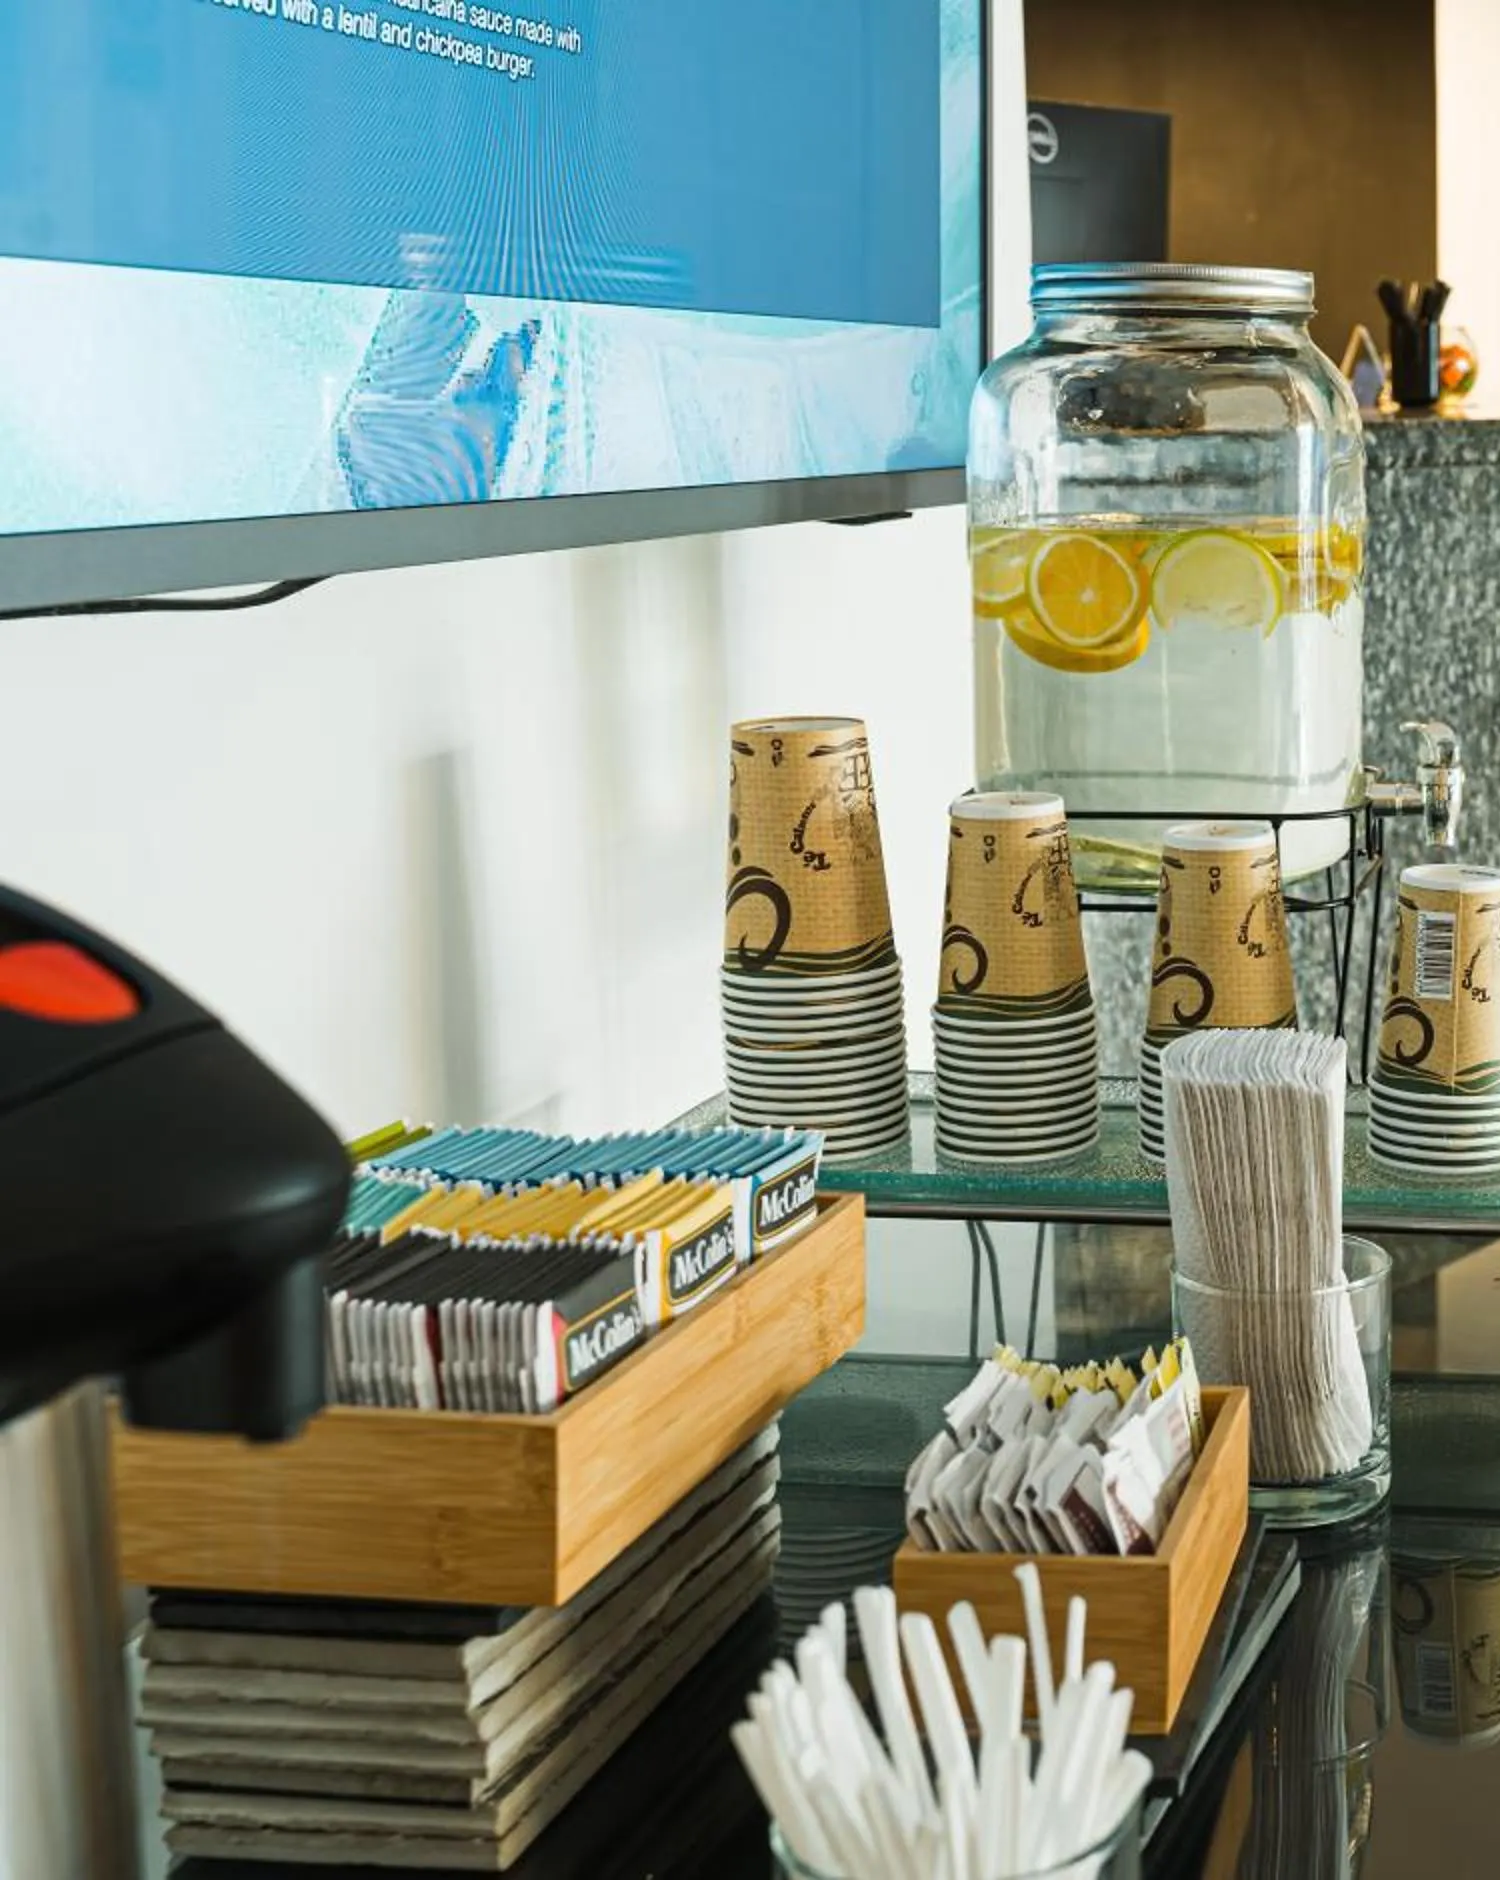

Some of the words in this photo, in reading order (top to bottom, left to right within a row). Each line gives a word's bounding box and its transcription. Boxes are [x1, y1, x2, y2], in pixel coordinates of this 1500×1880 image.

[281, 0, 318, 25] with
[321, 7, 334, 31] a
[338, 5, 377, 40] lentil
[381, 21, 412, 49] and
[416, 27, 483, 67] chickpea
[487, 43, 535, 80] burger.
[469, 5, 513, 35] sauce
[515, 17, 553, 46] made
[557, 26, 581, 53] with
